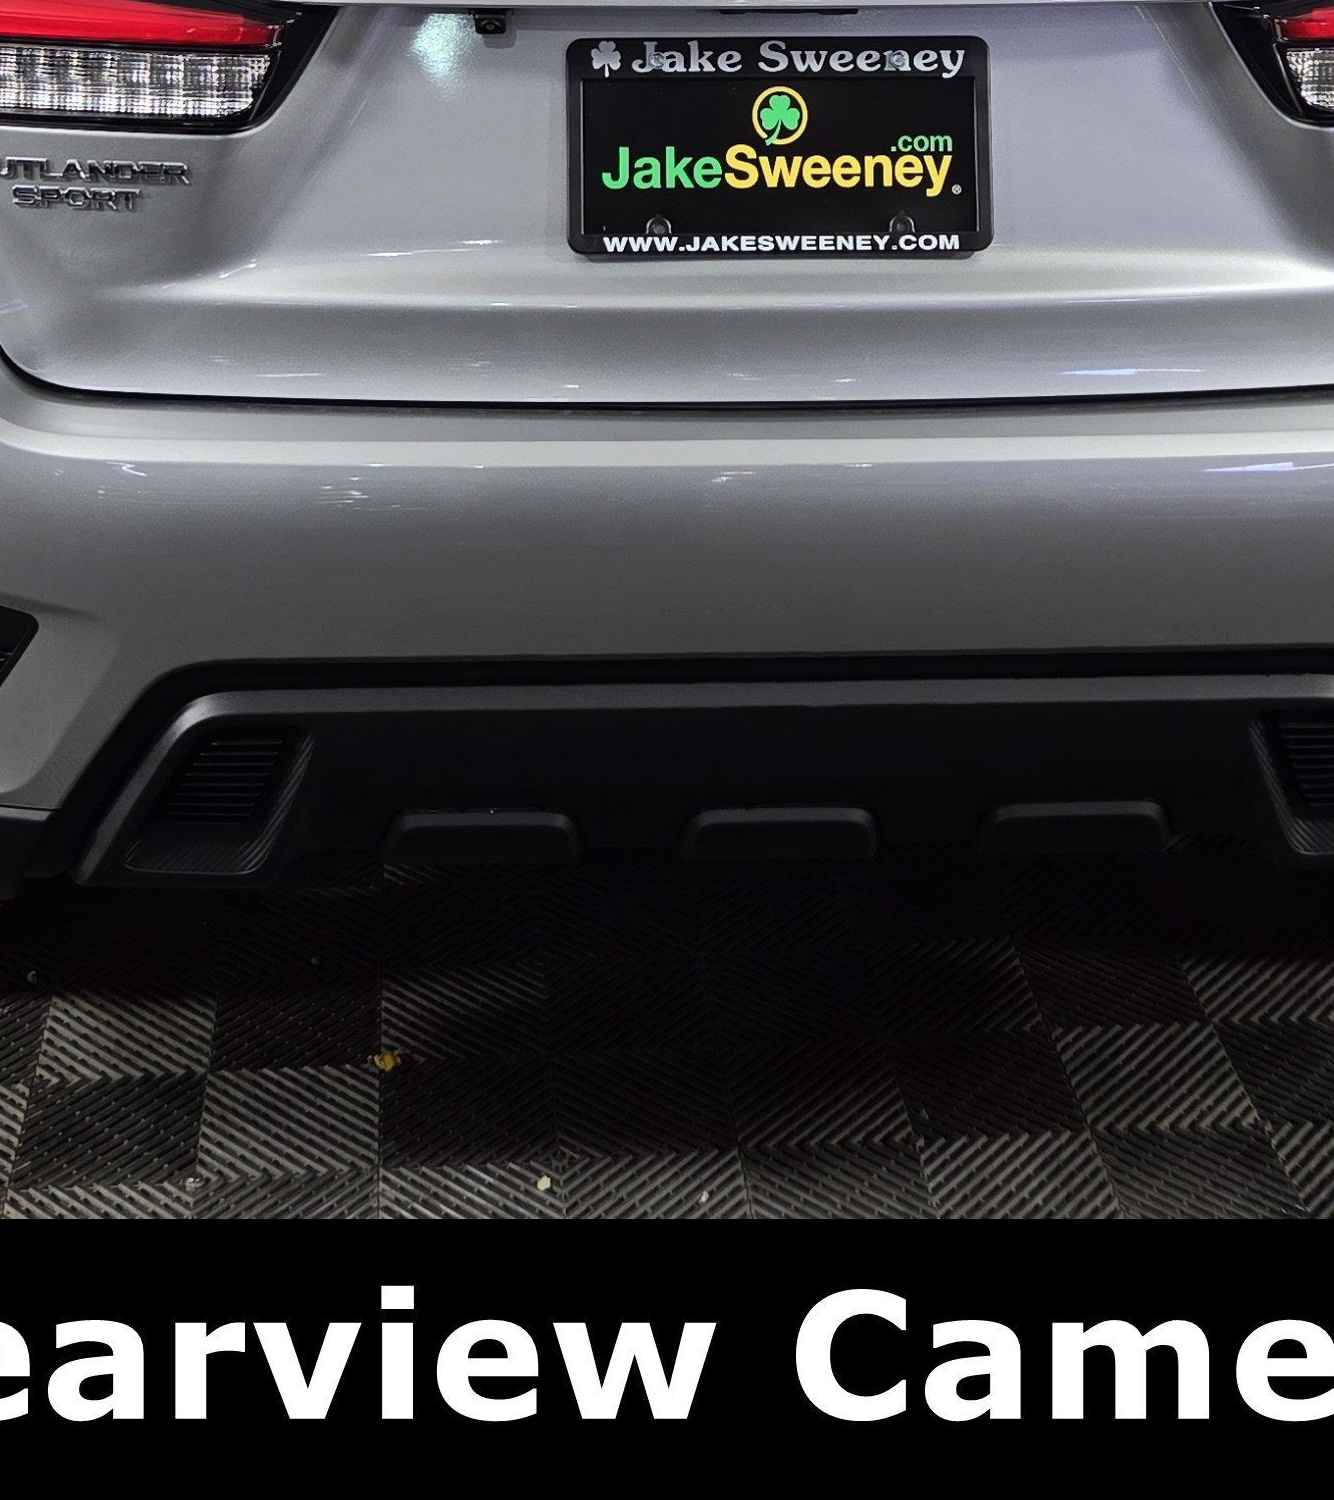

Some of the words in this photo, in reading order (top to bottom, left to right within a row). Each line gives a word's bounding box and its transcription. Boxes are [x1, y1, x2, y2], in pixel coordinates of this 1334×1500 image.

[632, 40, 742, 73] Jake
[758, 40, 966, 78] Sweeney
[11, 184, 142, 210] SPORT
[603, 234, 960, 252] WWW.JAKESWEENEY.COM
